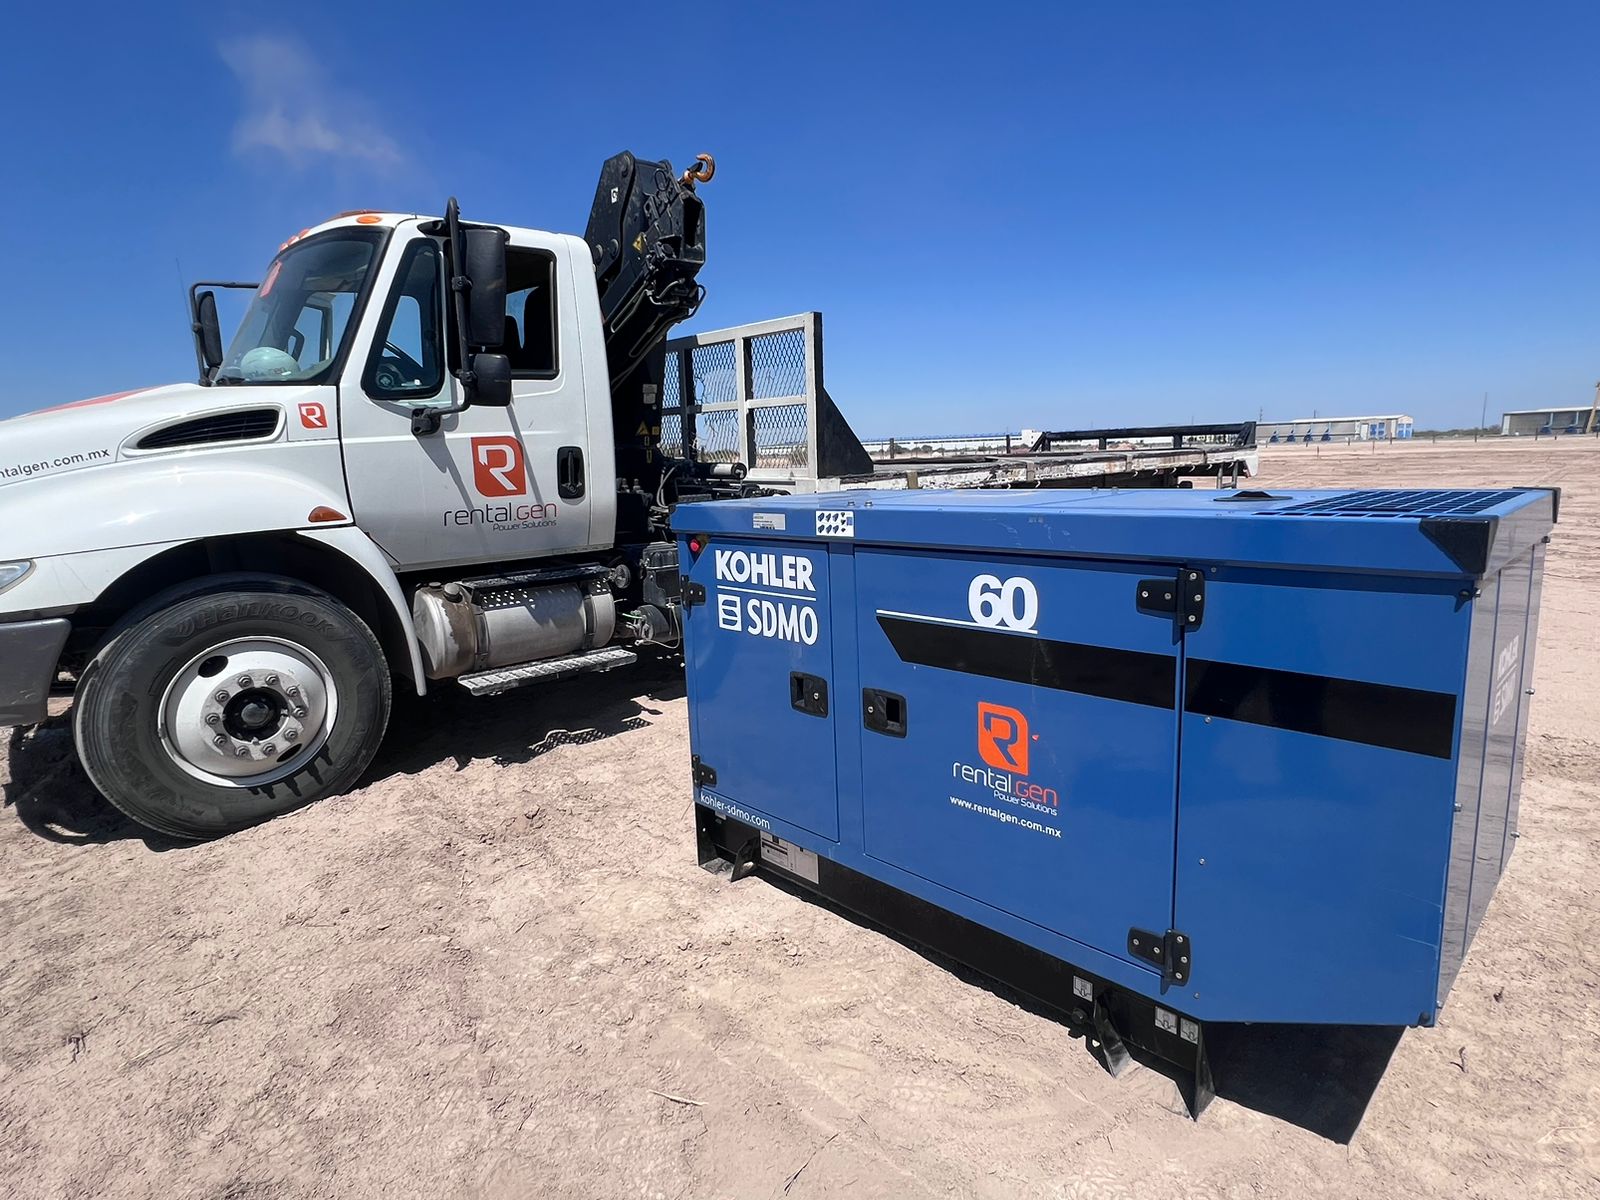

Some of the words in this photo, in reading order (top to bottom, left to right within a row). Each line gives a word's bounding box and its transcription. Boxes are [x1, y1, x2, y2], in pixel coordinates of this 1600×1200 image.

[492, 522, 520, 532] Power
[521, 519, 557, 530] Solutions
[715, 550, 816, 592] KOHLER
[747, 598, 818, 645] SDMO
[968, 574, 1038, 630] 60
[700, 792, 770, 829] kohler-sdmo.com
[949, 796, 1062, 839] www.rentalgen.com.mx
[993, 789, 1020, 805] Power
[1020, 798, 1058, 816] Solutions
